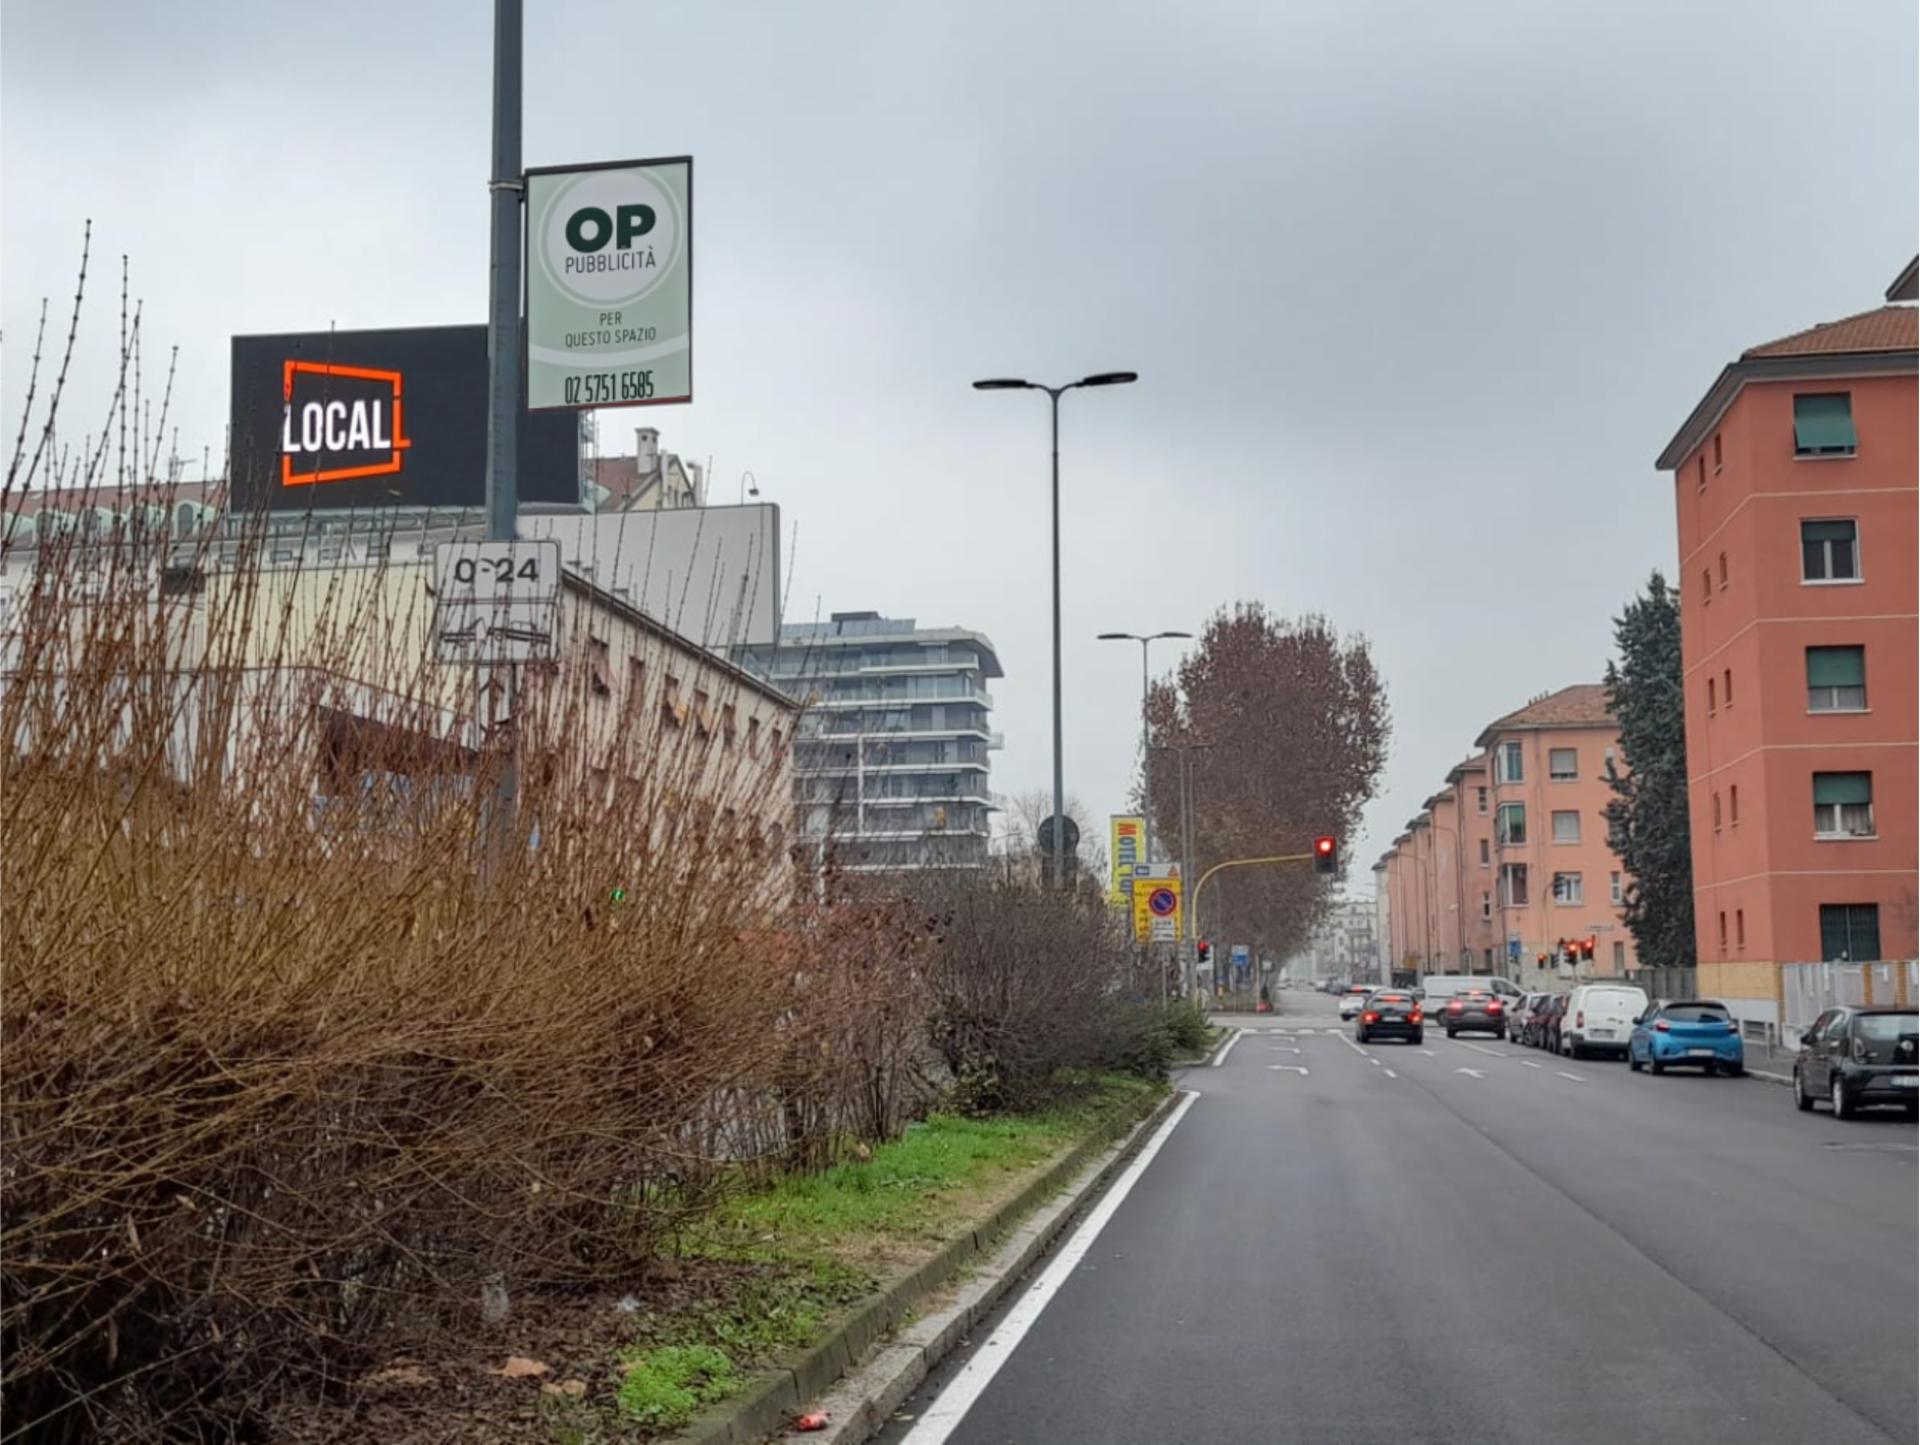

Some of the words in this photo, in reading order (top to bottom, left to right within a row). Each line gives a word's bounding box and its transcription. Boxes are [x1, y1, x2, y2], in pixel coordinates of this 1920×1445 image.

[565, 203, 656, 253] OP
[565, 246, 657, 274] PUBBLICITÀ
[599, 311, 622, 326] PER
[565, 329, 611, 348] QUESTO
[615, 327, 657, 343] SPAZIO
[564, 375, 582, 404] 02
[585, 373, 617, 403] 5751
[621, 370, 654, 400] 6585
